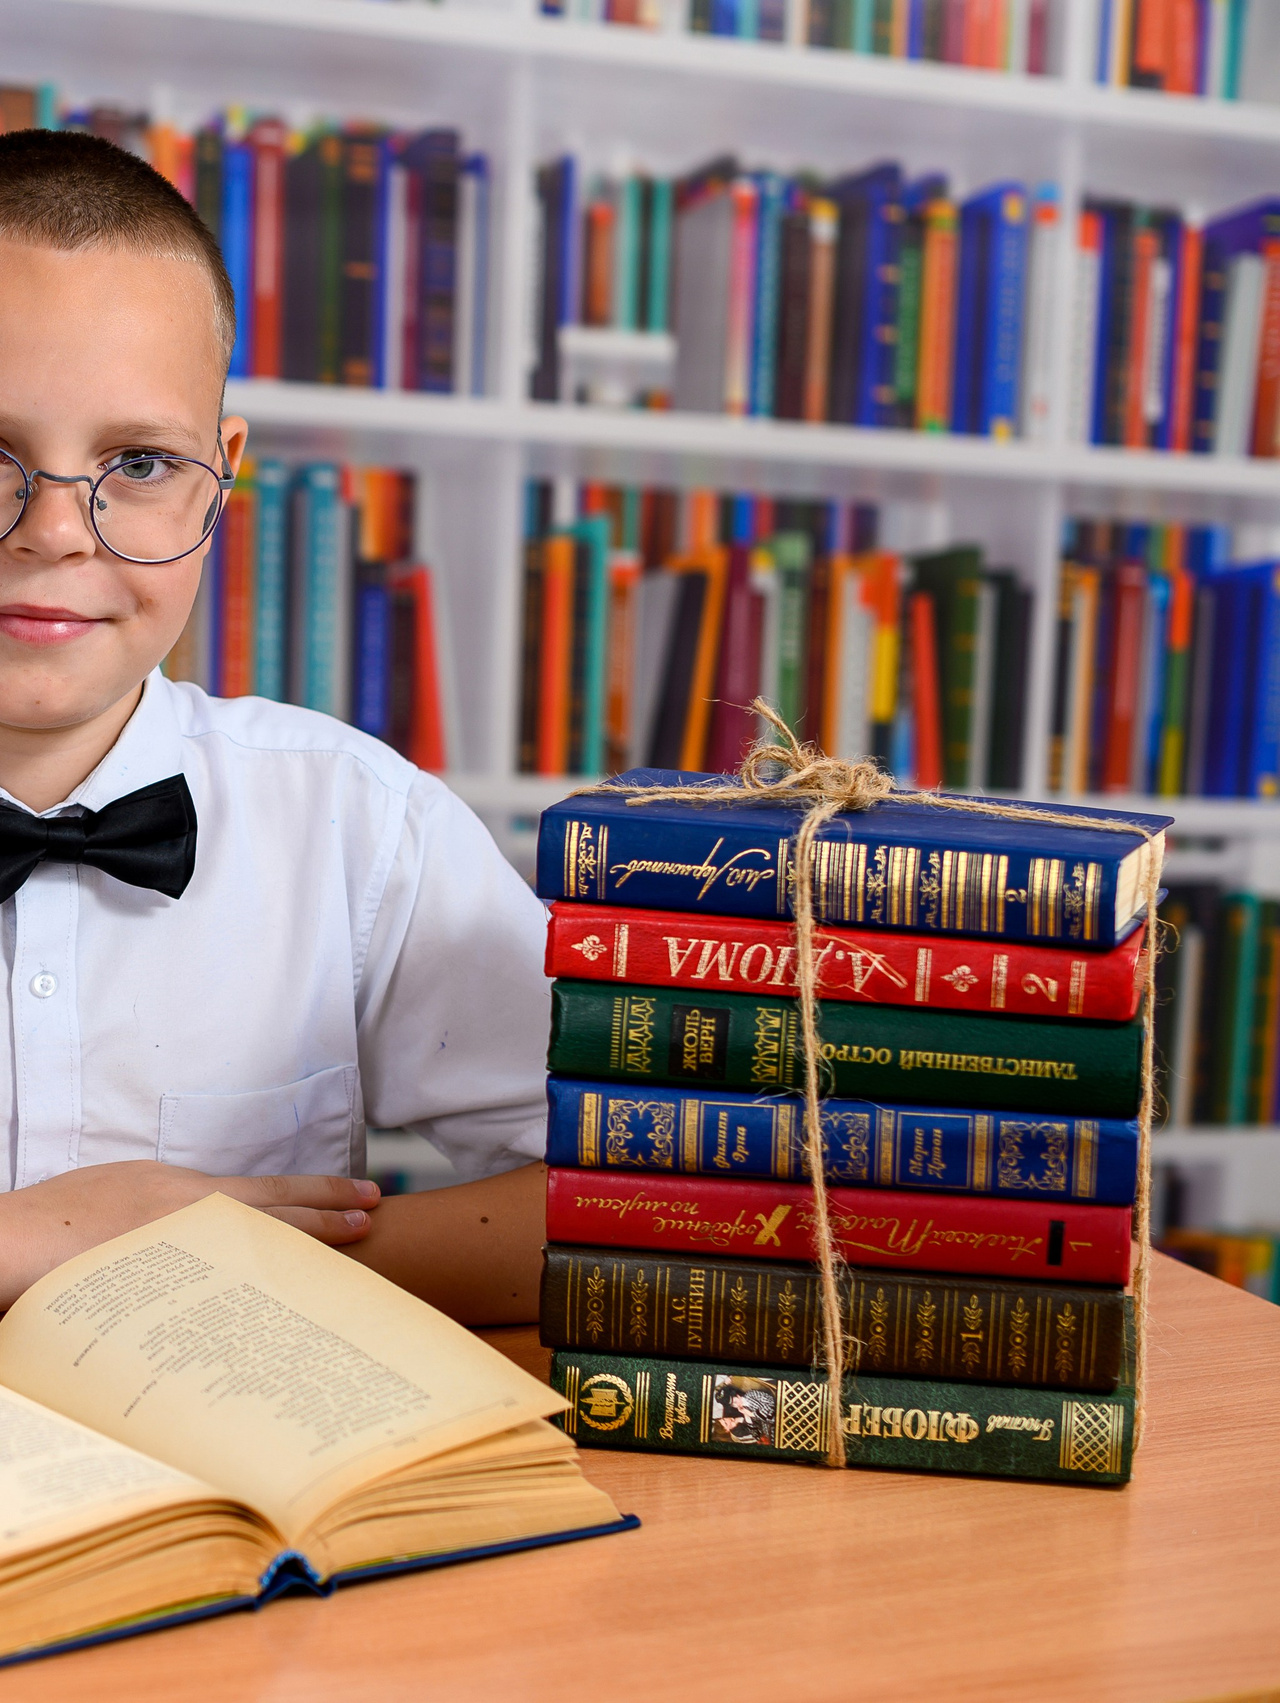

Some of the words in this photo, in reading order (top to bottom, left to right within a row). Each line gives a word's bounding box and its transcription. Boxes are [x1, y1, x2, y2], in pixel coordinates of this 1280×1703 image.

[609, 837, 771, 901] Лермонтов
[1004, 888, 1027, 904] 2
[835, 950, 886, 991] А.
[1021, 973, 1059, 1002] 2
[683, 1009, 702, 1071] ЖЮЛЬ
[699, 1017, 717, 1064] ВЕРН
[814, 1042, 893, 1065] ОСТРО
[898, 1049, 1079, 1081] ТАИНСТВЕННЫЙ
[712, 1111, 731, 1169] Филипп
[908, 1128, 929, 1177] Морис
[926, 1128, 947, 1180] Дрюон
[573, 1191, 670, 1219] мукам
[670, 1201, 700, 1217] по
[651, 1204, 792, 1248] Хождение
[929, 1229, 1045, 1262] Алексей
[1069, 1240, 1094, 1253] 1
[671, 1297, 687, 1324] А.С.
[960, 1330, 984, 1343] 1
[658, 1372, 677, 1440] Воспитание
[841, 1402, 980, 1444] ФЛОБЕР
[985, 1414, 1055, 1442] Гюстав
